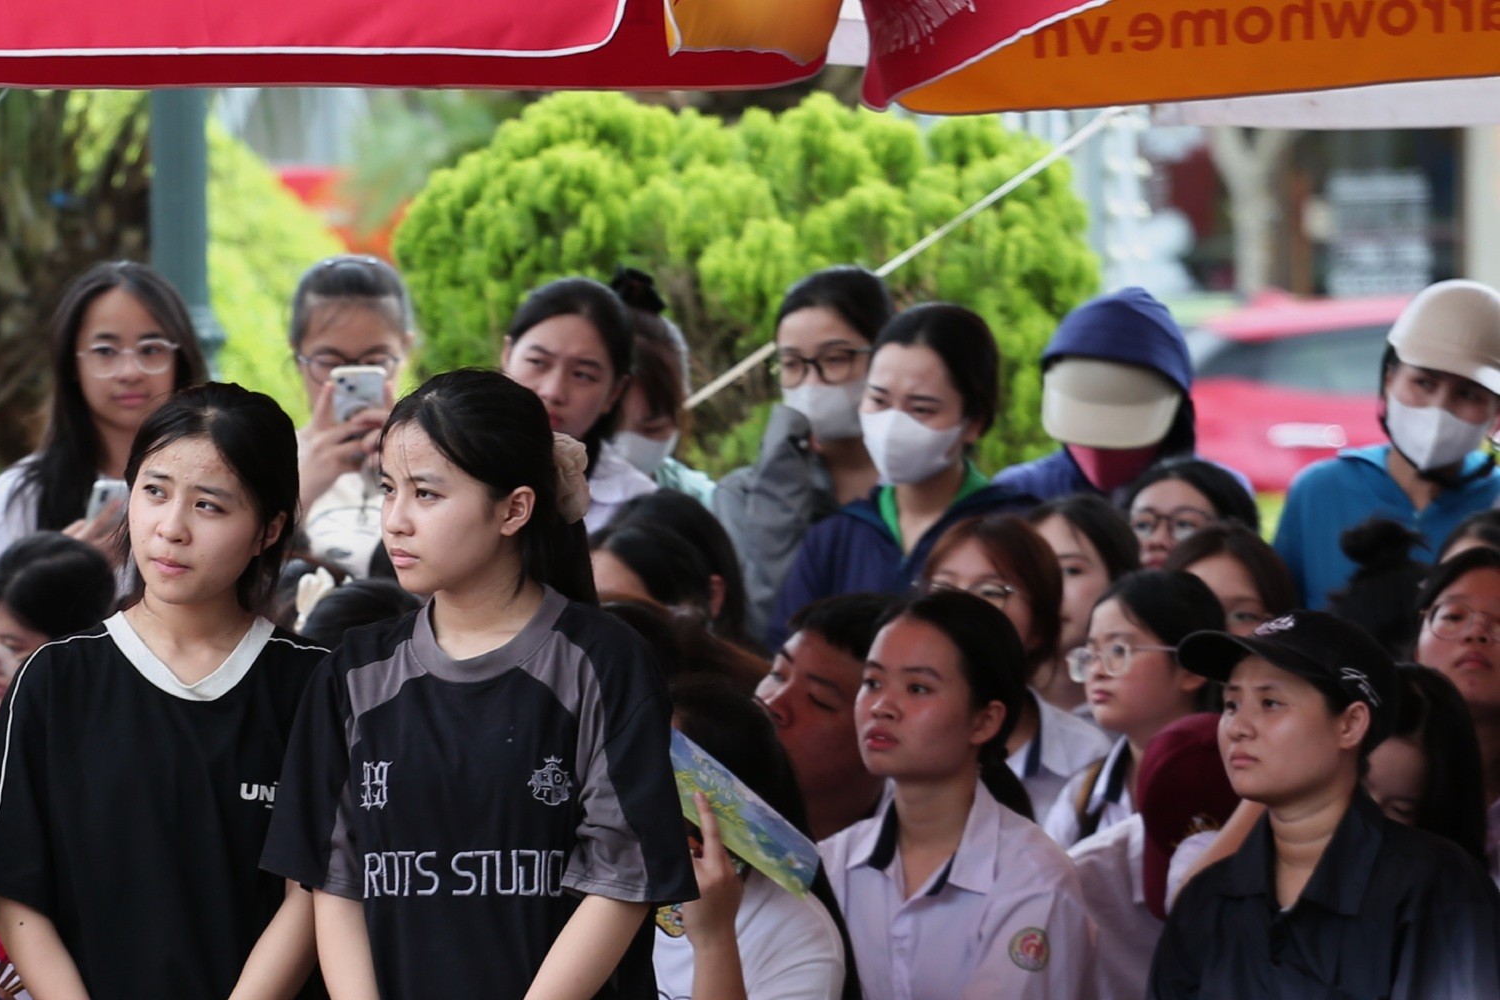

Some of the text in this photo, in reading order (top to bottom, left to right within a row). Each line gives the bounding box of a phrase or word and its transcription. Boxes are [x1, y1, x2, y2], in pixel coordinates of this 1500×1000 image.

[240, 781, 280, 802] UN
[363, 850, 564, 899] ROTS STUDIO
